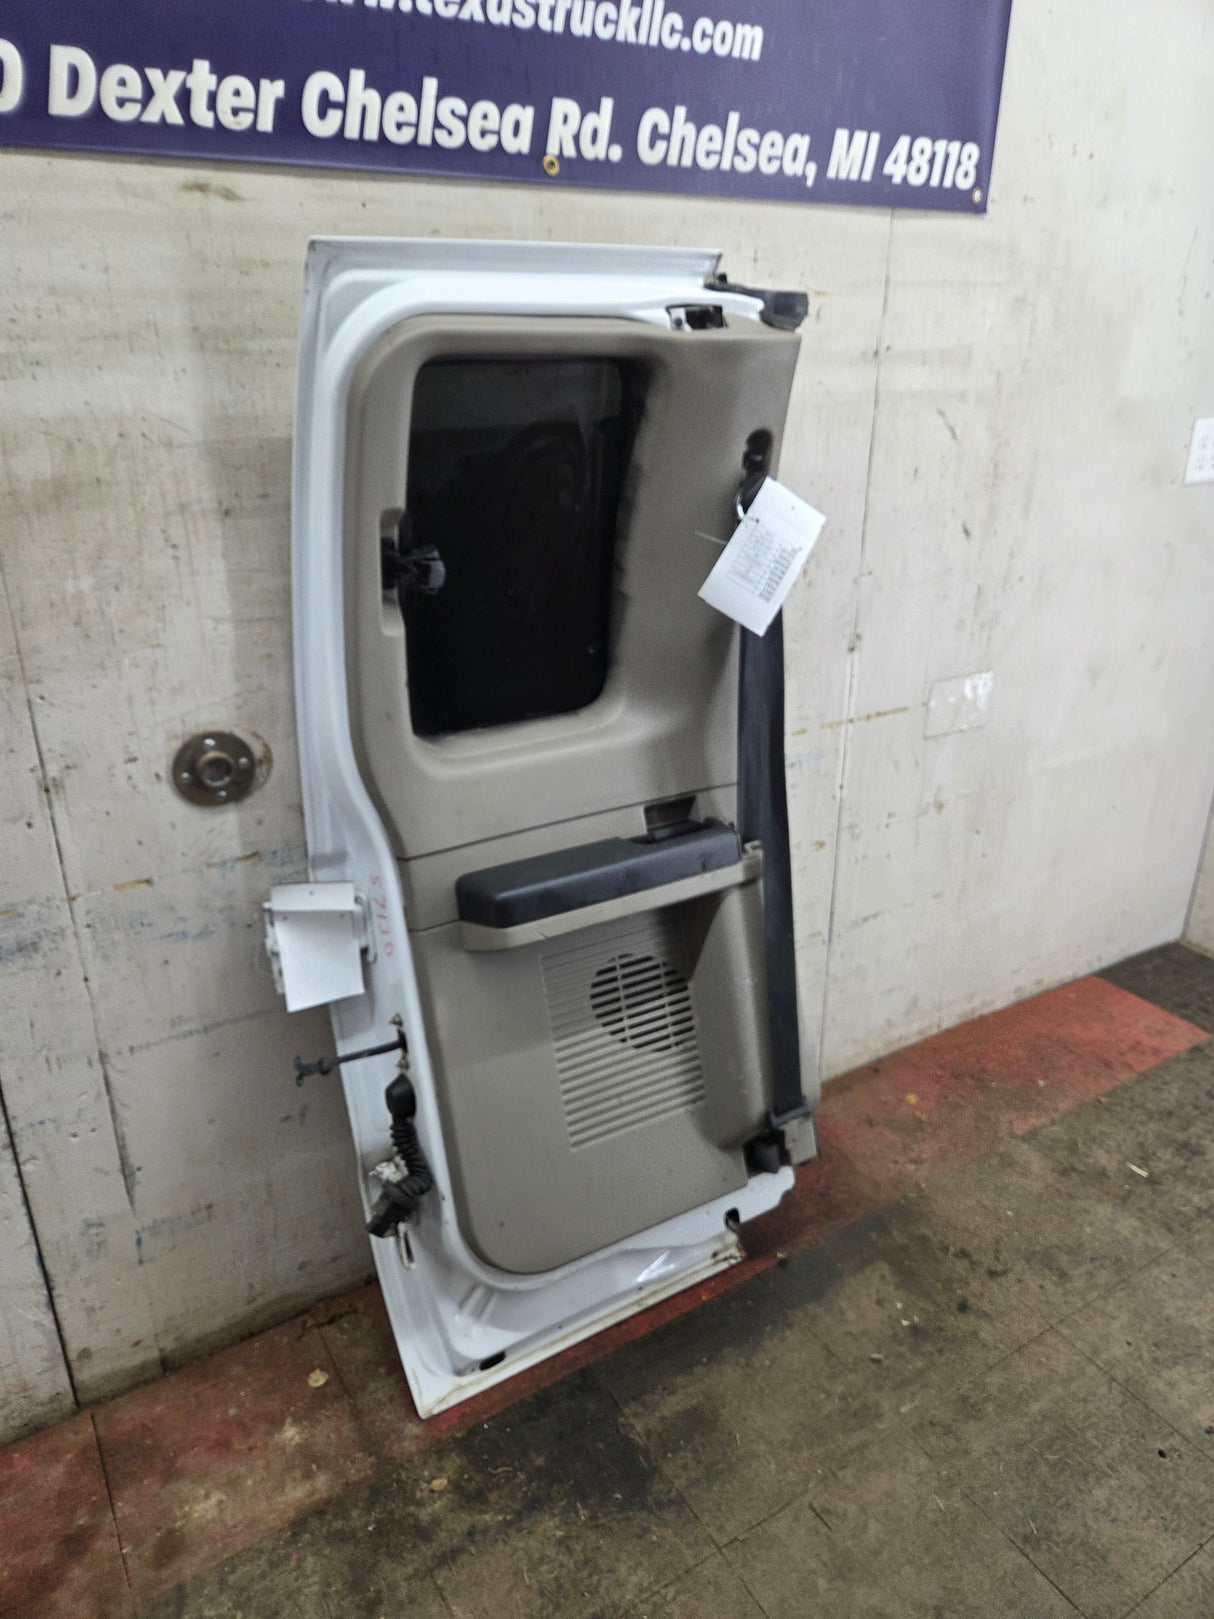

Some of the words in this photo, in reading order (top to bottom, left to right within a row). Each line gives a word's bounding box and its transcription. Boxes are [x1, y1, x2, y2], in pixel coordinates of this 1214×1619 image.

[325, 0, 765, 61] .xastruckllc.com
[48, 44, 285, 133] Dexter
[301, 68, 535, 154] Chelsea
[546, 96, 623, 163] Rd.
[637, 104, 818, 188] Chelsea,
[826, 127, 881, 182] MI
[882, 134, 981, 191] 48118
